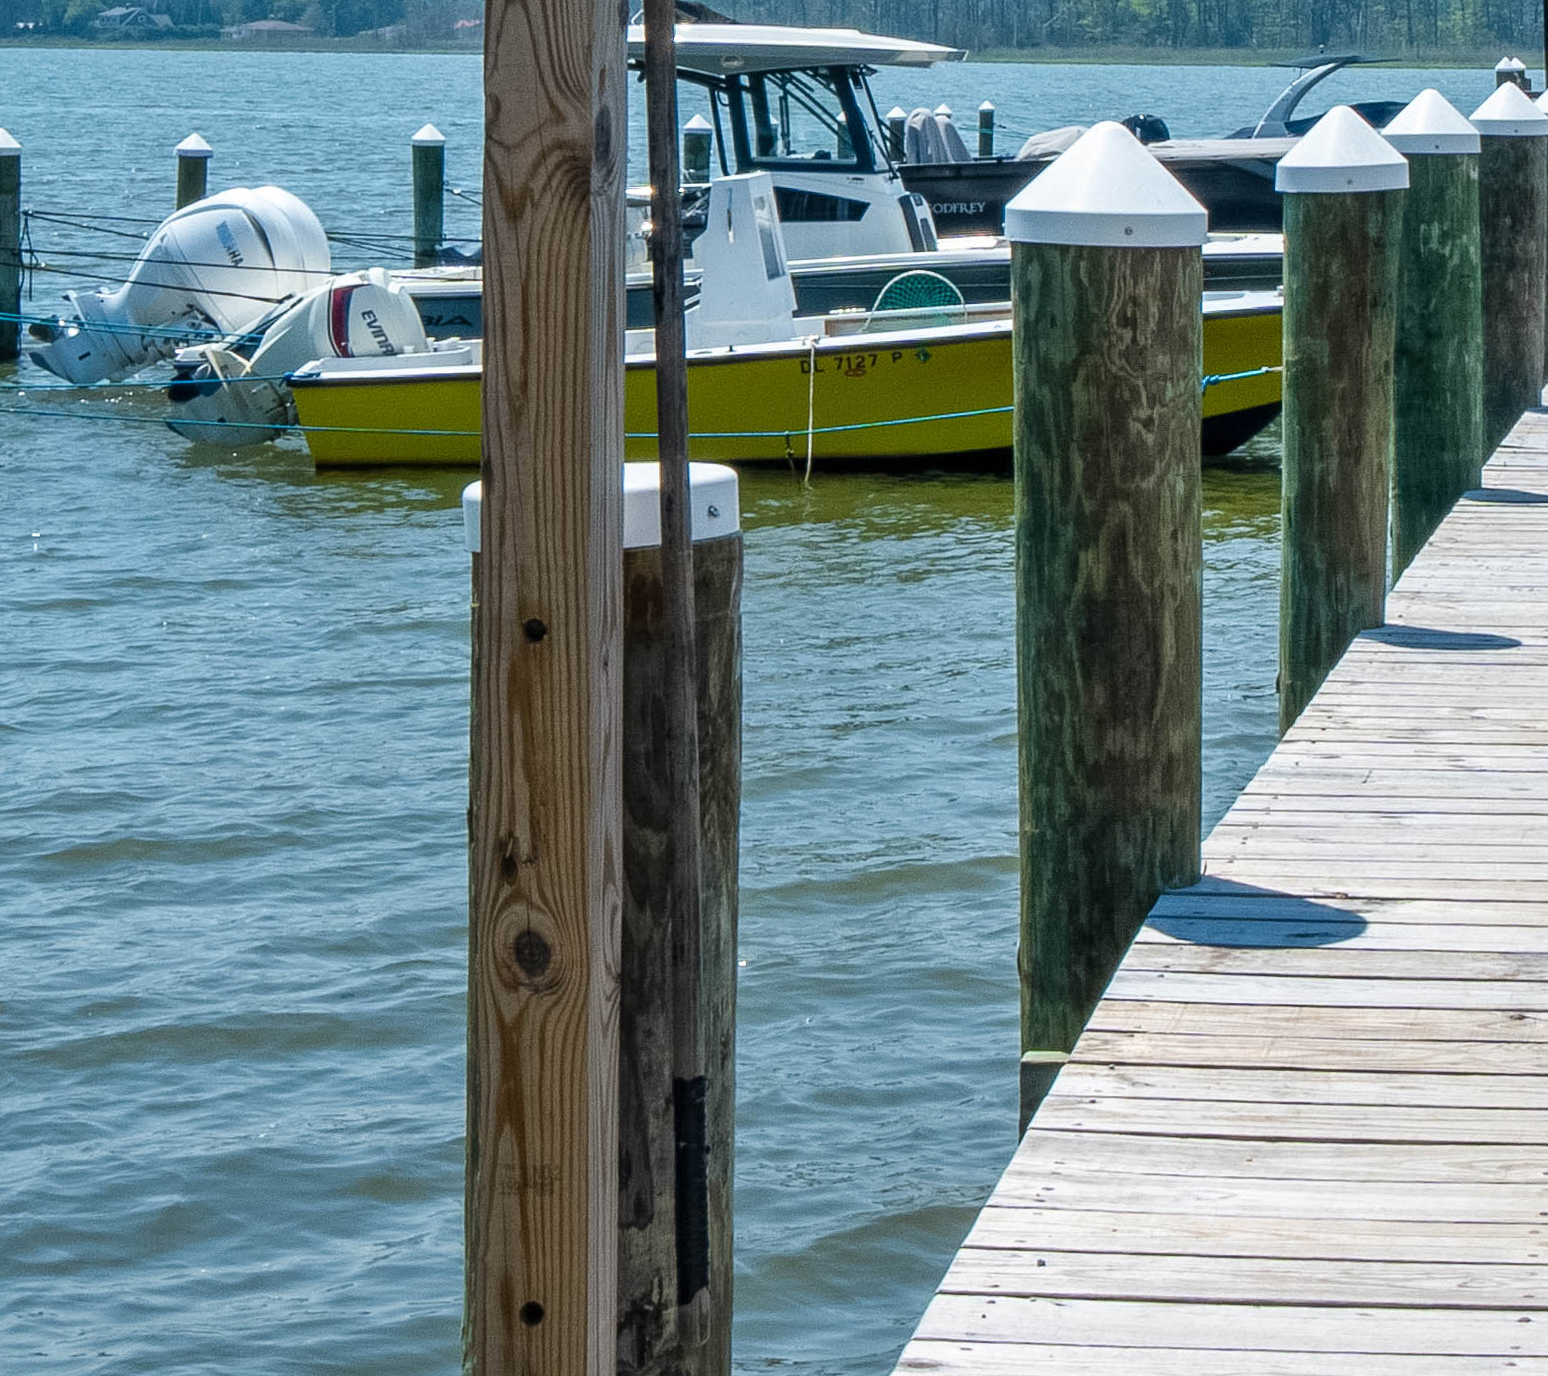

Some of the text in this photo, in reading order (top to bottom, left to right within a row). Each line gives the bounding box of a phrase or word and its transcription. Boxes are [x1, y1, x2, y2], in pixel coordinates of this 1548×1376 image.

[930, 200, 987, 216] ODFREY
[833, 353, 879, 371] 7127
[892, 351, 903, 363] P
